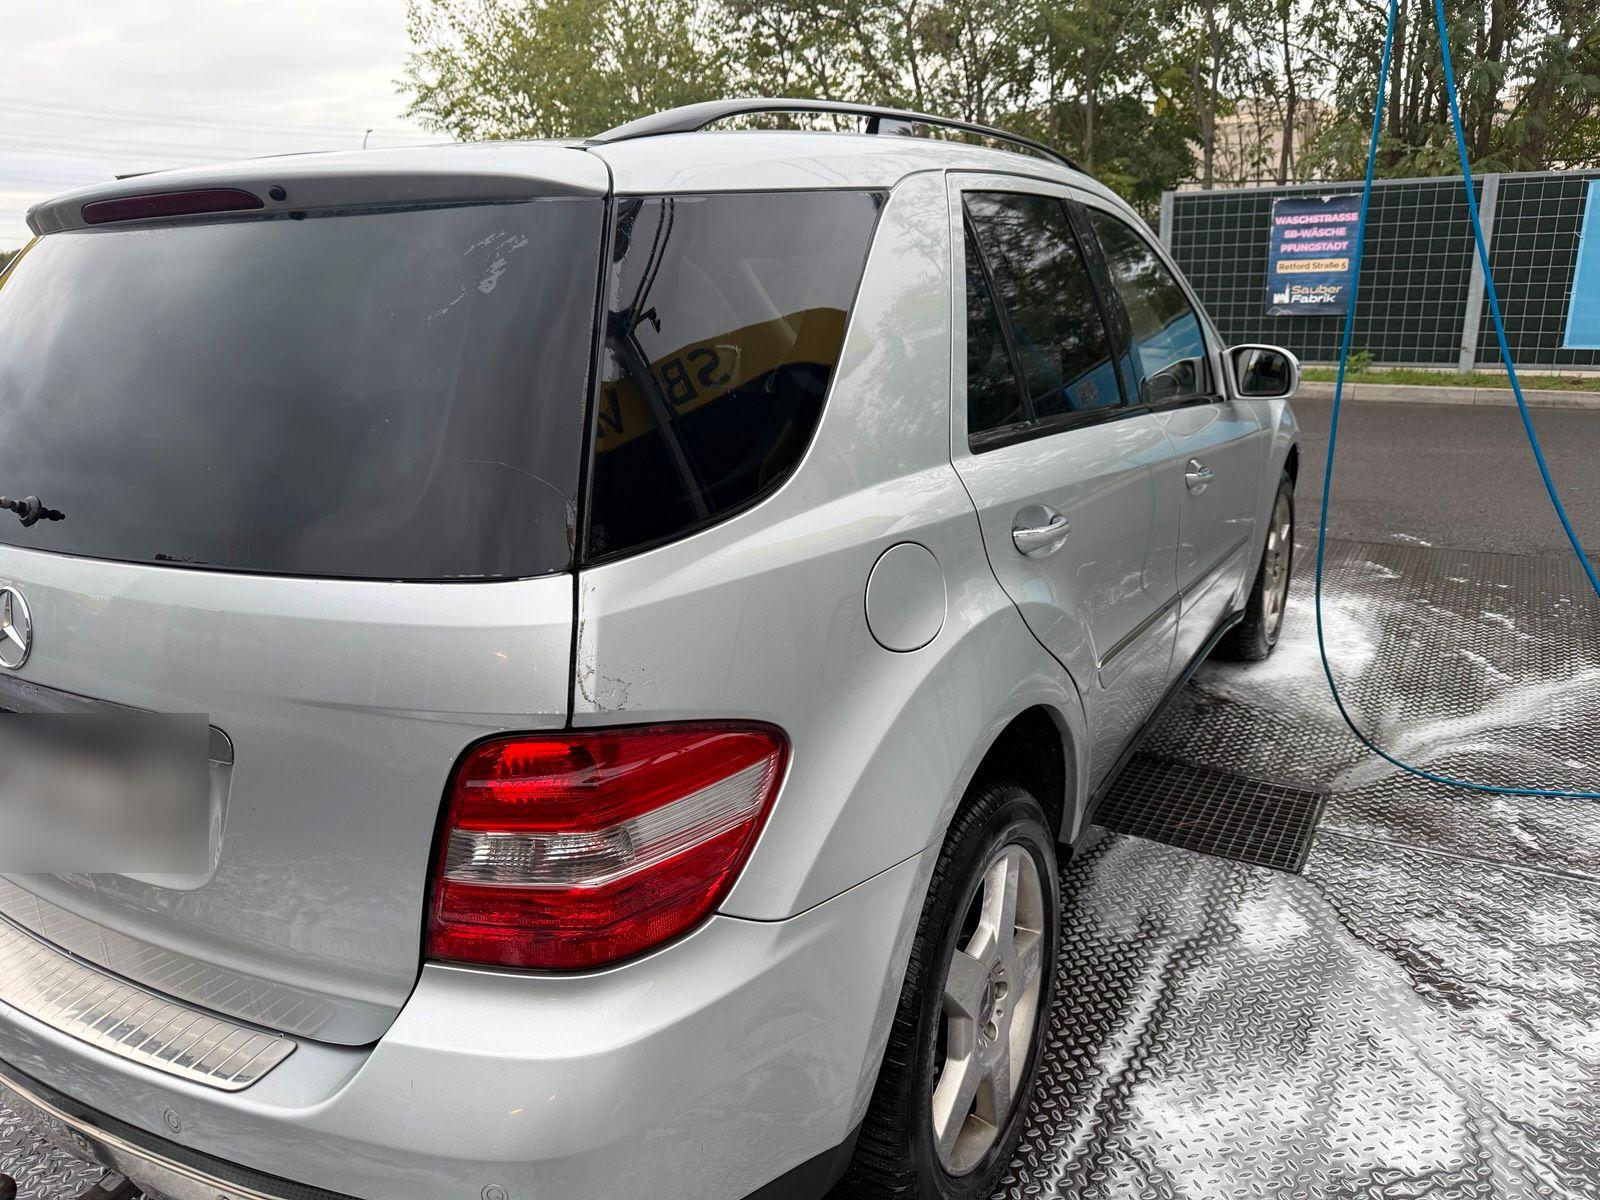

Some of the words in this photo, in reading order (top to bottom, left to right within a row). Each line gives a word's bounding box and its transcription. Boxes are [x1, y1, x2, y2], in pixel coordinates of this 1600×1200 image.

[1275, 213, 1358, 225] WASCHSTRASSE
[1284, 227, 1347, 239] SB-WÄSCHE
[1280, 242, 1349, 253] PFUNGSTADT
[1279, 262, 1310, 270] Retford
[1312, 261, 1340, 270] Straße
[1291, 285, 1343, 294] Sauber
[1290, 293, 1336, 303] Fabrik
